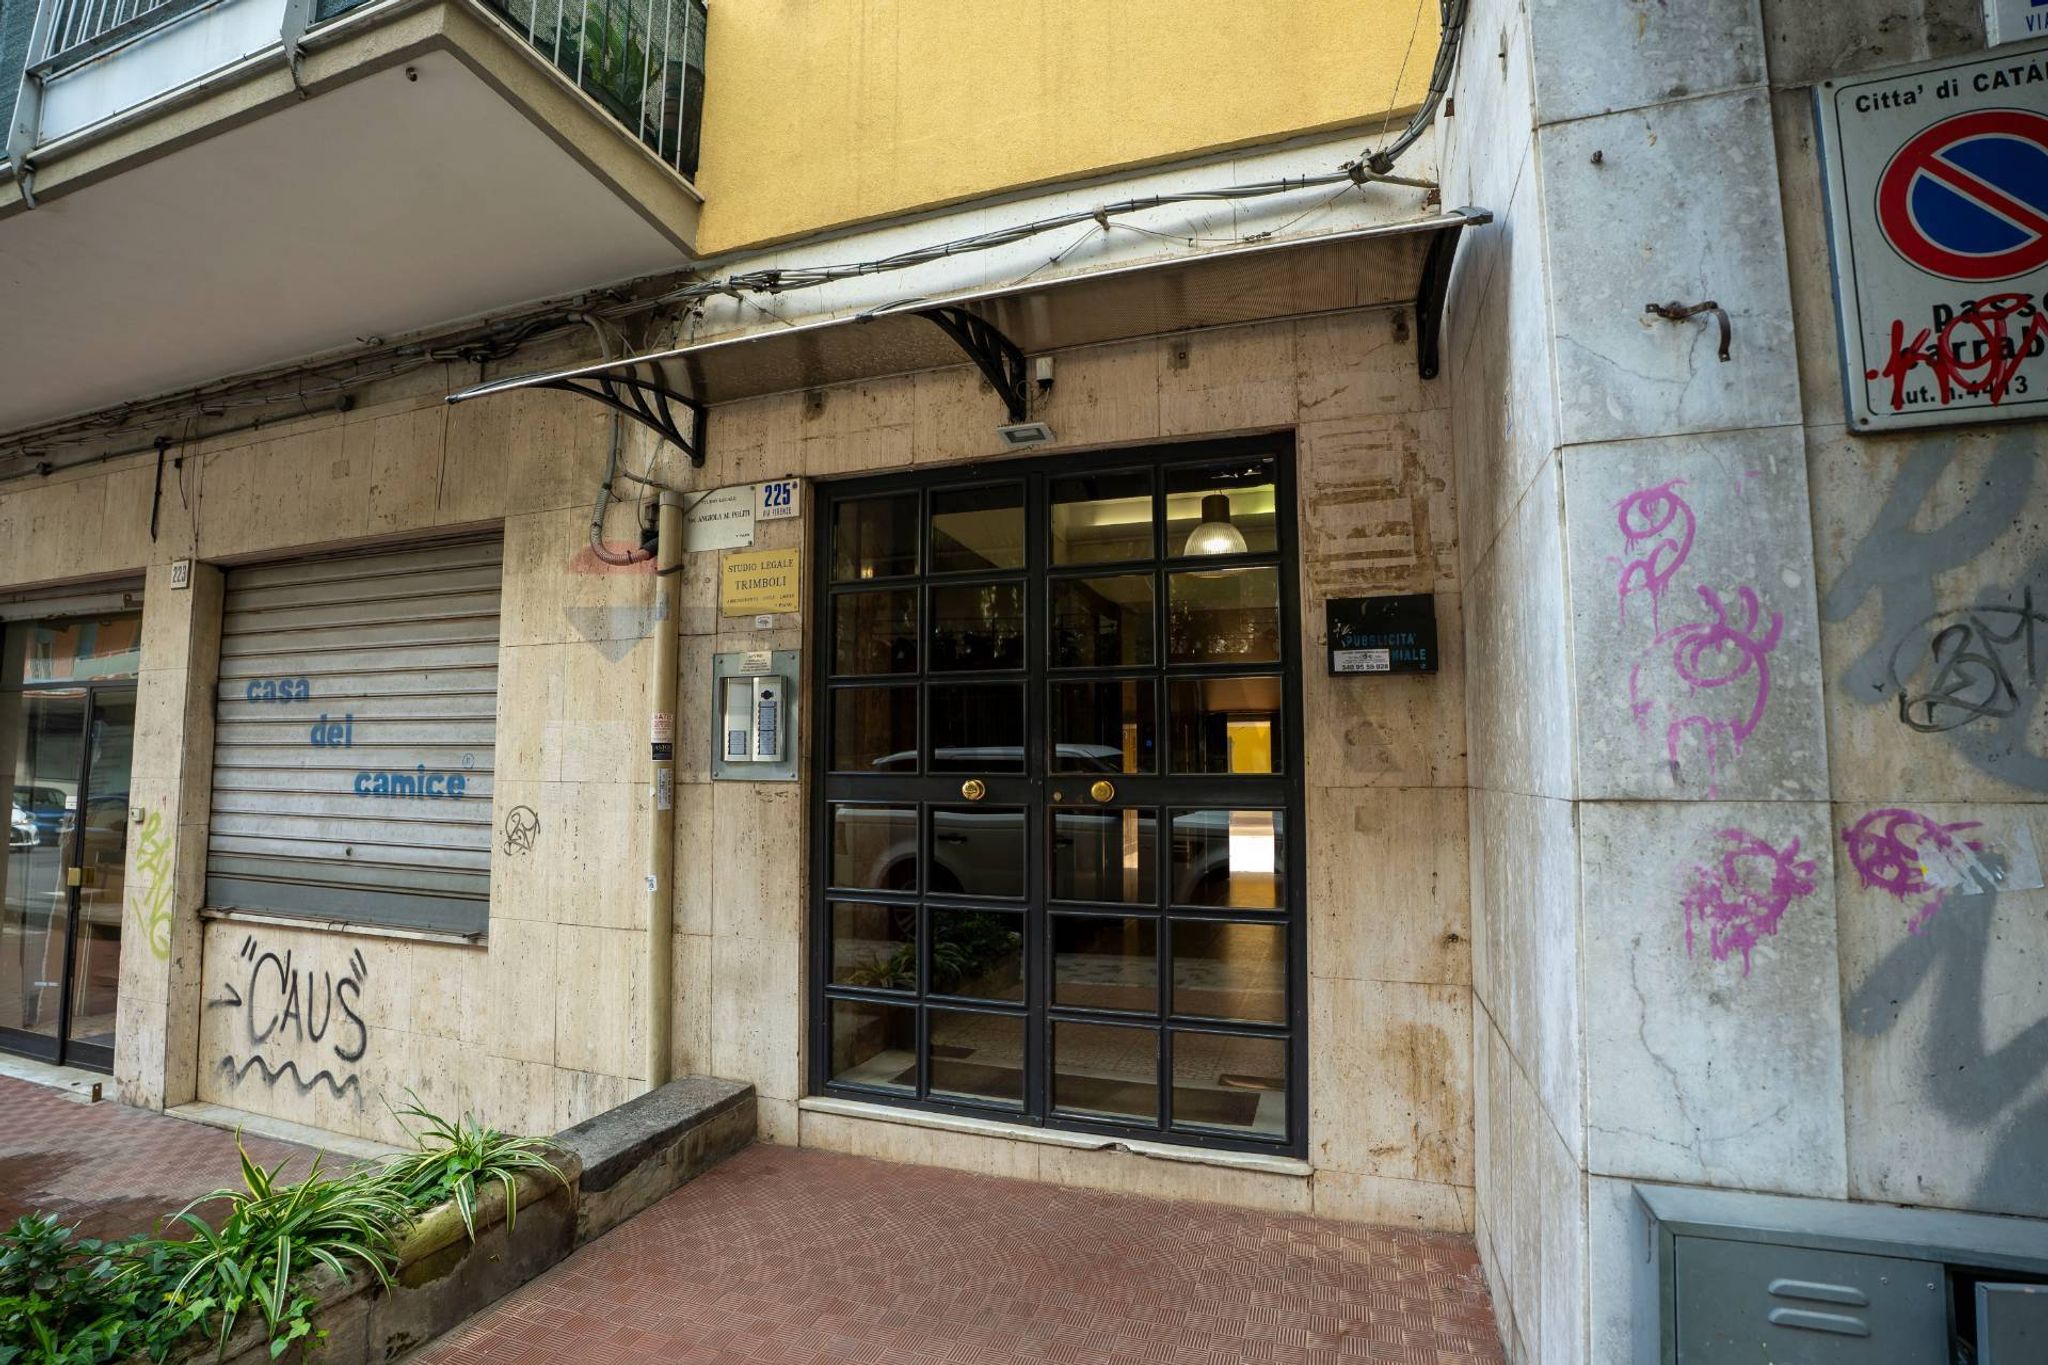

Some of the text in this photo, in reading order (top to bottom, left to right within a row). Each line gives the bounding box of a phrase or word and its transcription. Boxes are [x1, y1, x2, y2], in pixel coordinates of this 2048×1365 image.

[1936, 78, 1959, 99] di
[1973, 61, 2048, 92] CATA
[1891, 384, 1936, 406] ut.
[764, 483, 791, 508] 225
[172, 566, 188, 584] 223
[728, 558, 794, 573] STUDIO LEGALE
[736, 576, 786, 590] TRIMBOLI
[245, 677, 310, 704] casa
[310, 714, 354, 749] del
[354, 764, 467, 801] camice
